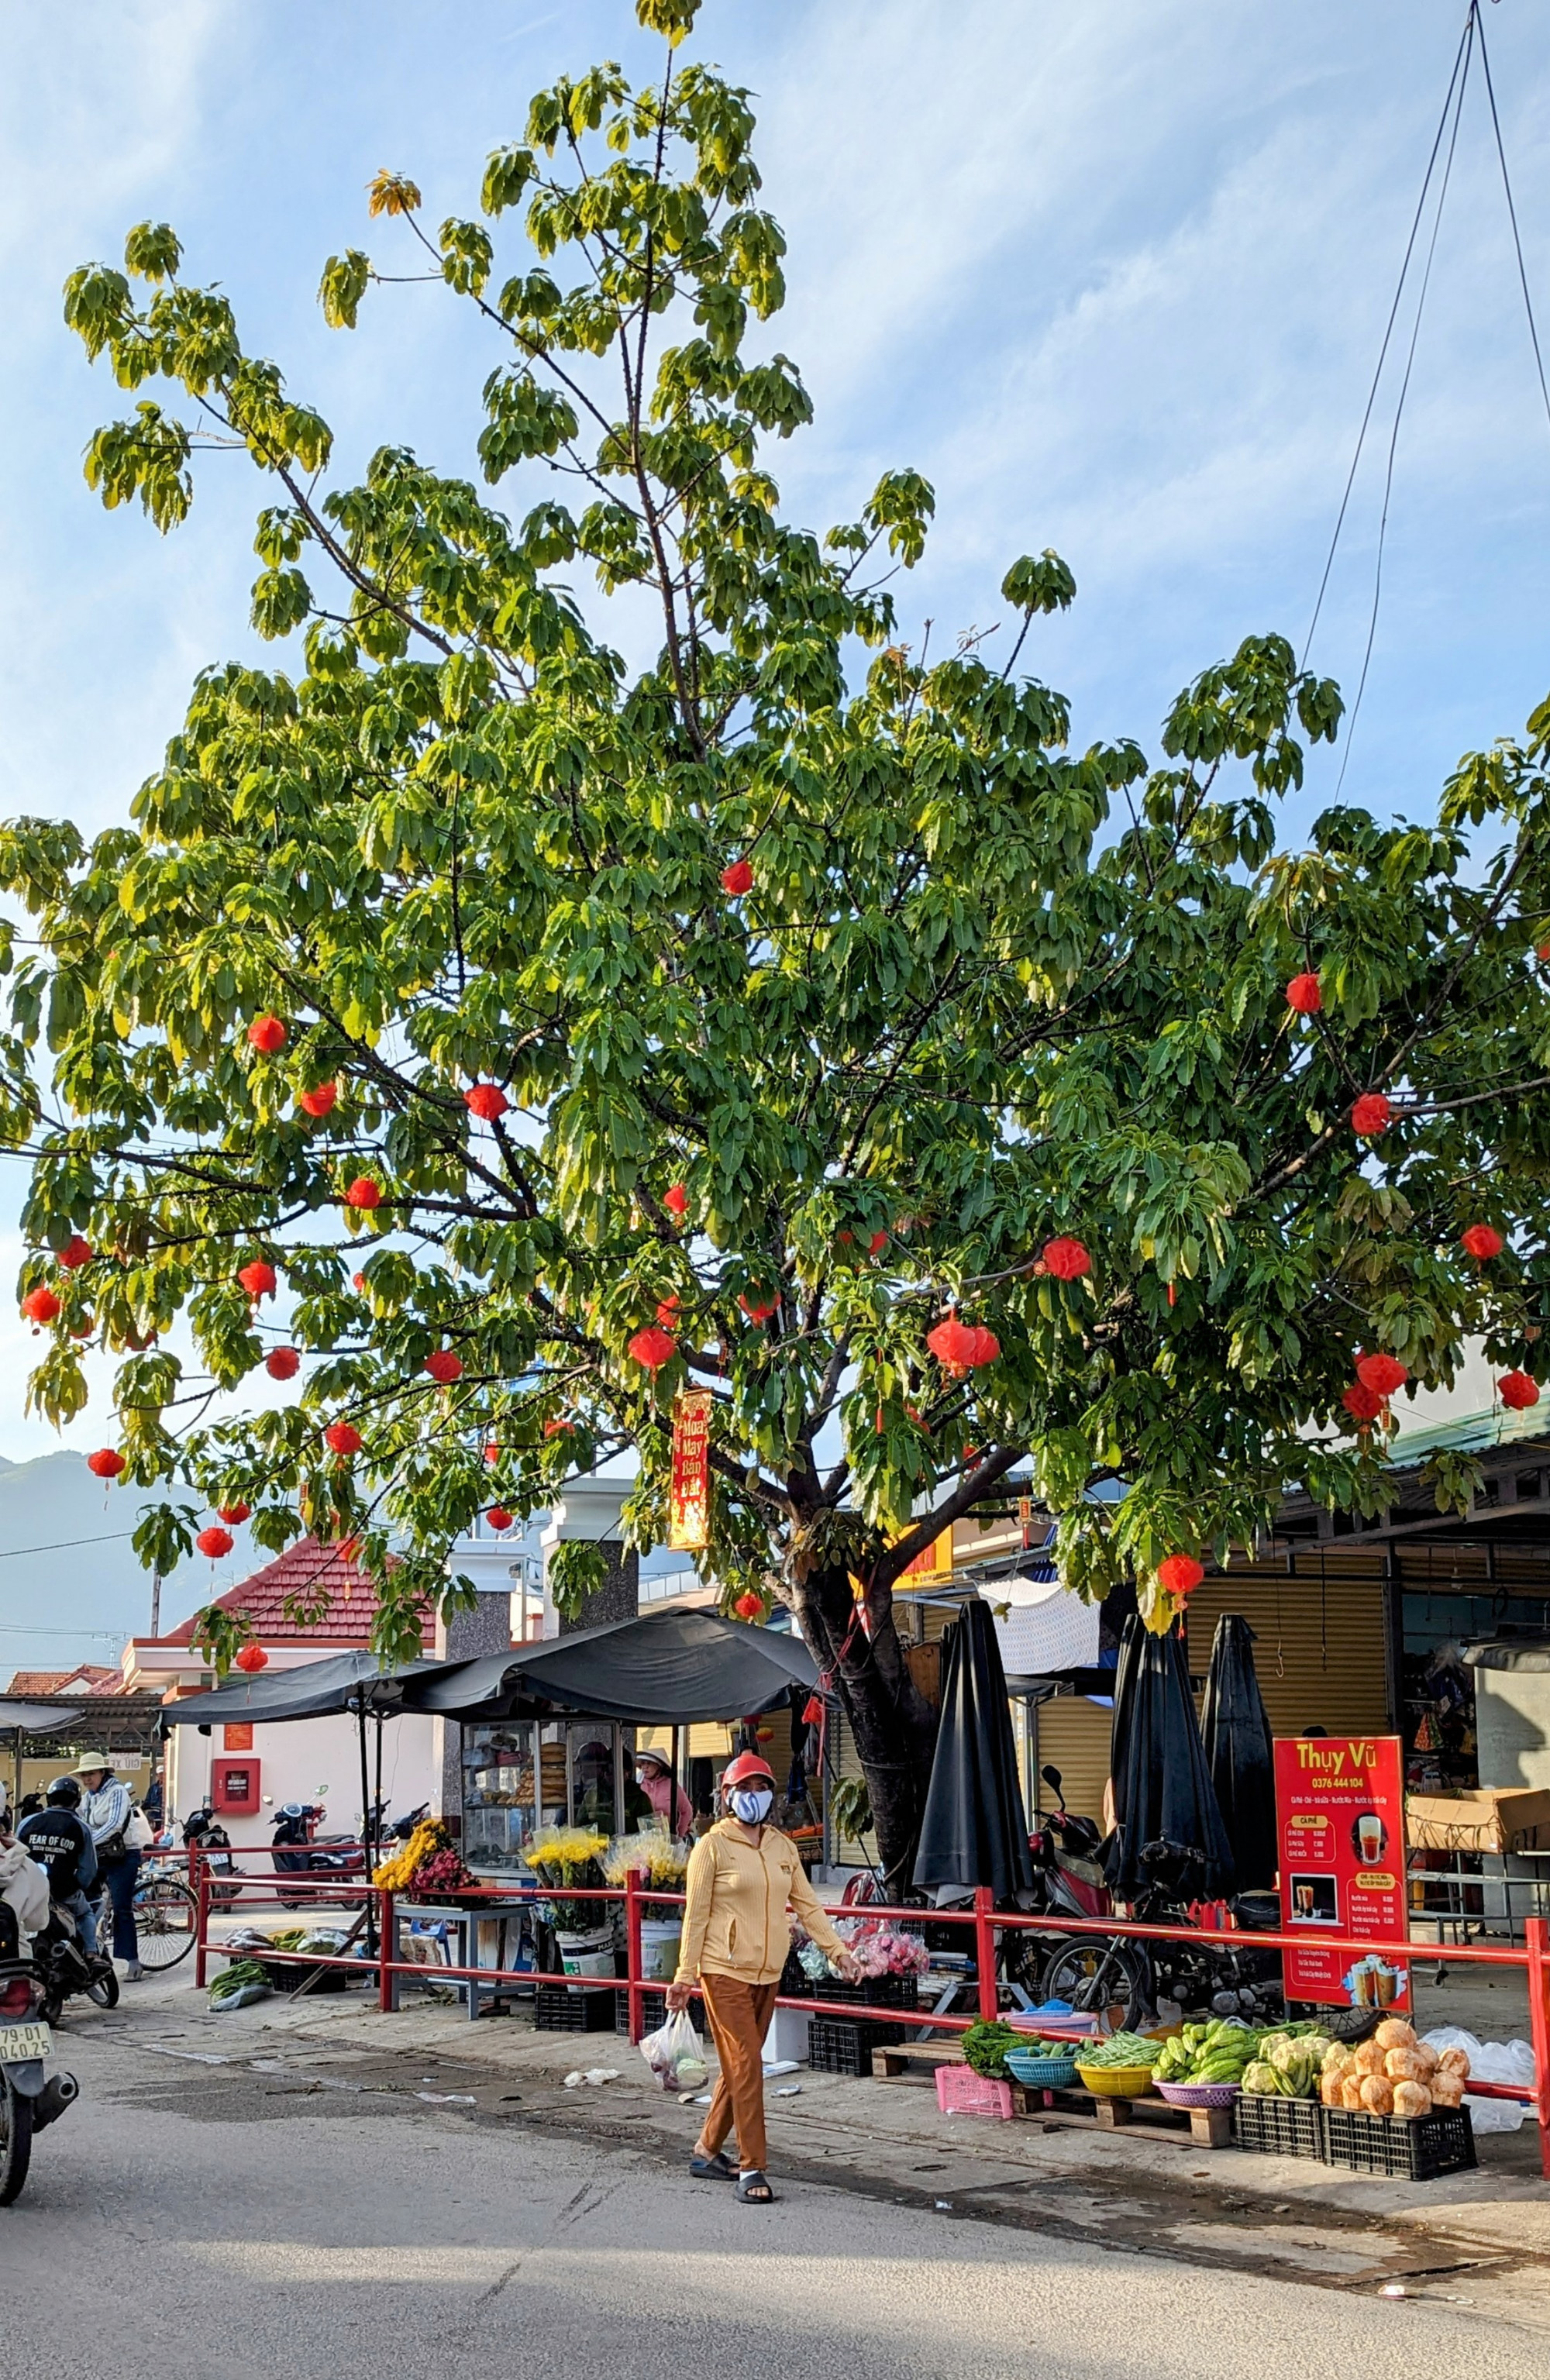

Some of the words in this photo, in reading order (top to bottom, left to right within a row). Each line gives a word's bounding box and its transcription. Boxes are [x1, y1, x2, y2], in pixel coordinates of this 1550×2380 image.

[682, 1438, 703, 1459] May
[682, 1457, 701, 1476] Bán
[1297, 1742, 1345, 1775] Thụy
[1348, 1742, 1376, 1768] Vũ
[1312, 1778, 1332, 1788] 0376
[1333, 1778, 1348, 1788] 444
[1349, 1778, 1363, 1787] 104
[29, 1834, 46, 1844] FEAR
[48, 1835, 60, 1846] OF
[60, 1838, 75, 1850] GOD
[43, 1854, 55, 1864] XV
[1, 2026, 41, 2044] 79-D1
[0, 2041, 50, 2059] 040.25
